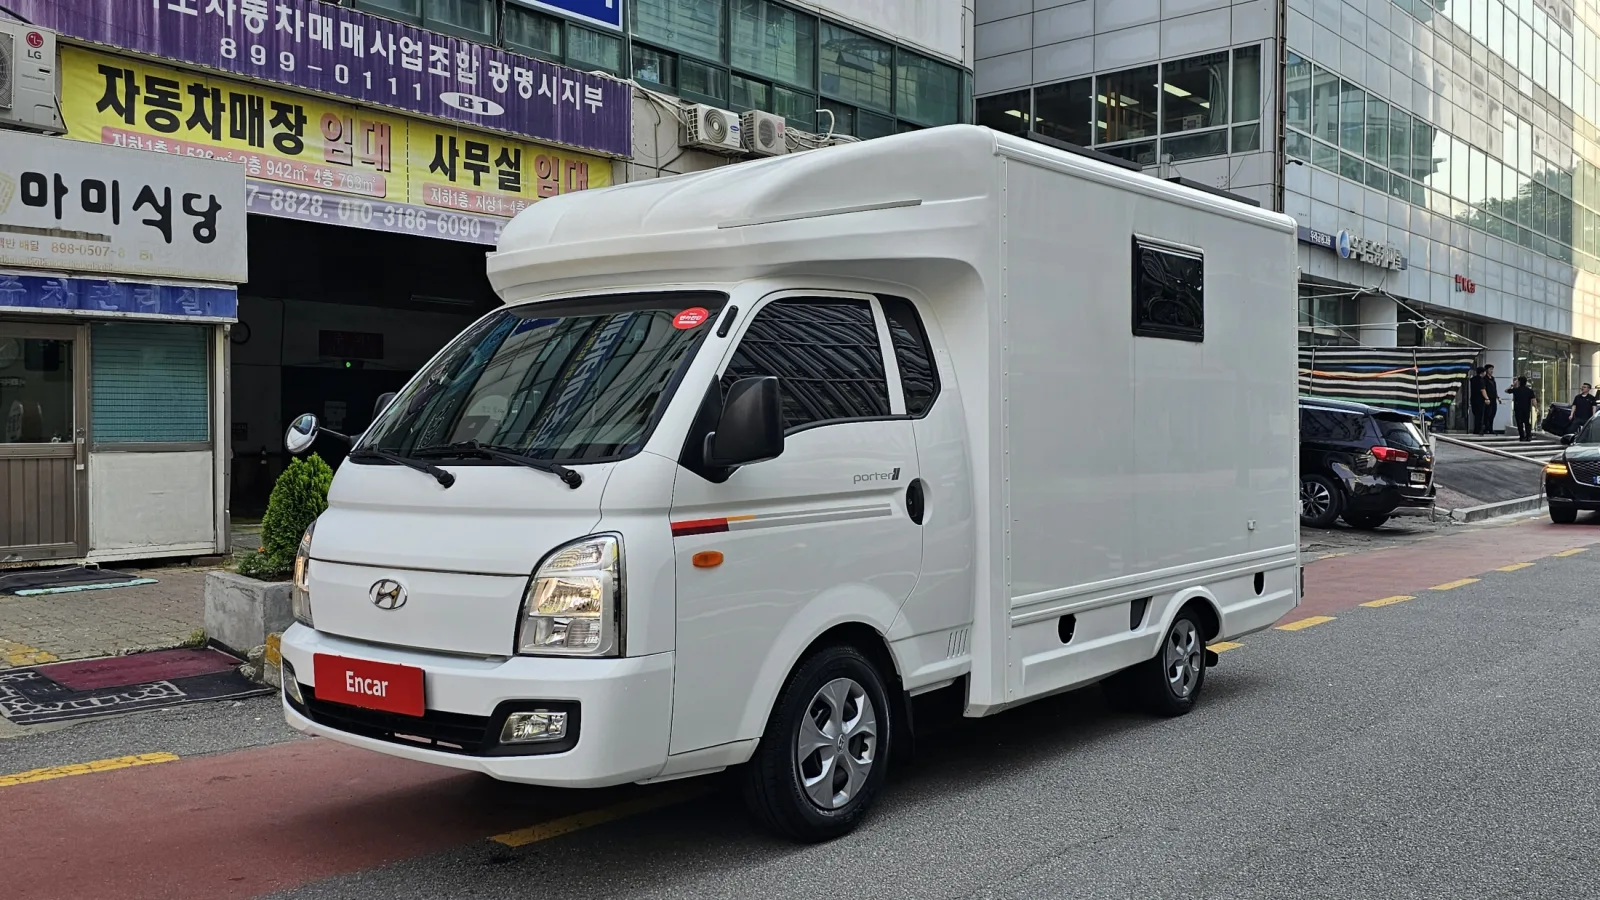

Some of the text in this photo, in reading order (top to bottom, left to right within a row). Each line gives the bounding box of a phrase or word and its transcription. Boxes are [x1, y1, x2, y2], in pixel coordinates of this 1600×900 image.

[27, 49, 42, 60] LG
[487, 59, 604, 114] 광명시지부
[458, 95, 489, 114] B1
[95, 63, 589, 199] 자동차매장 임대 사무실 임대
[313, 169, 335, 187] 4층
[20, 171, 223, 245] 마미식당
[338, 199, 481, 238] 010-3186-6090
[345, 670, 388, 697] Encar
